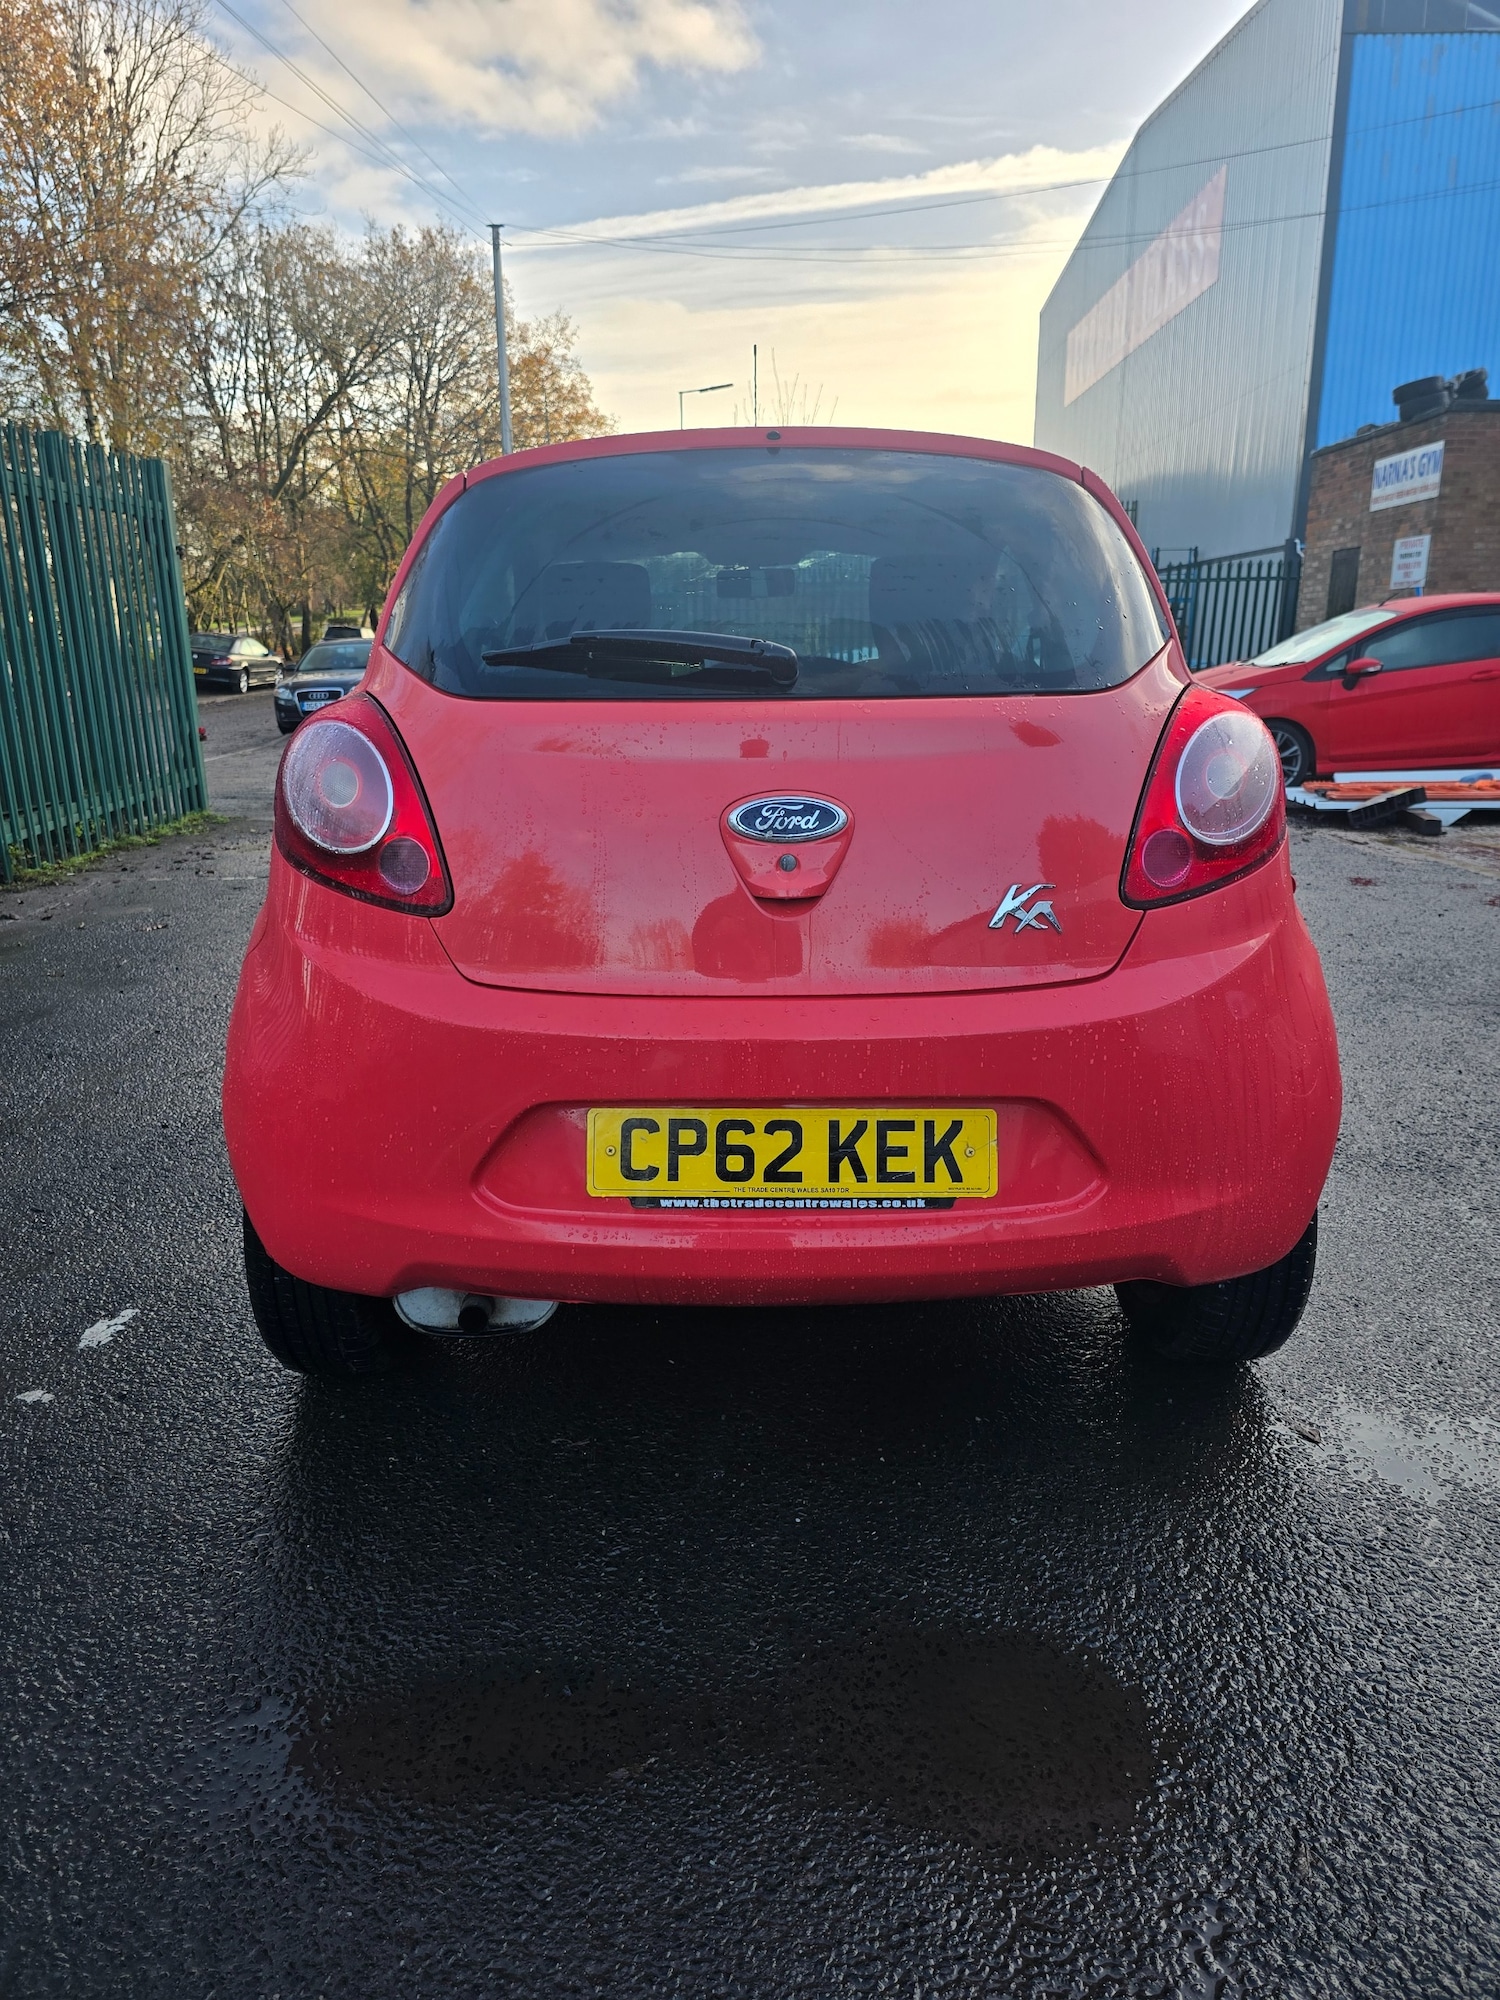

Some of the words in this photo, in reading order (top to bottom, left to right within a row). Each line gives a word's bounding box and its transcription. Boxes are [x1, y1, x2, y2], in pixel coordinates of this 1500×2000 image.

[754, 803, 820, 831] Ford
[619, 1117, 804, 1183] CP62
[828, 1119, 964, 1184] KEK
[659, 1198, 926, 1209] www.thetradecentrewales.co.uk
